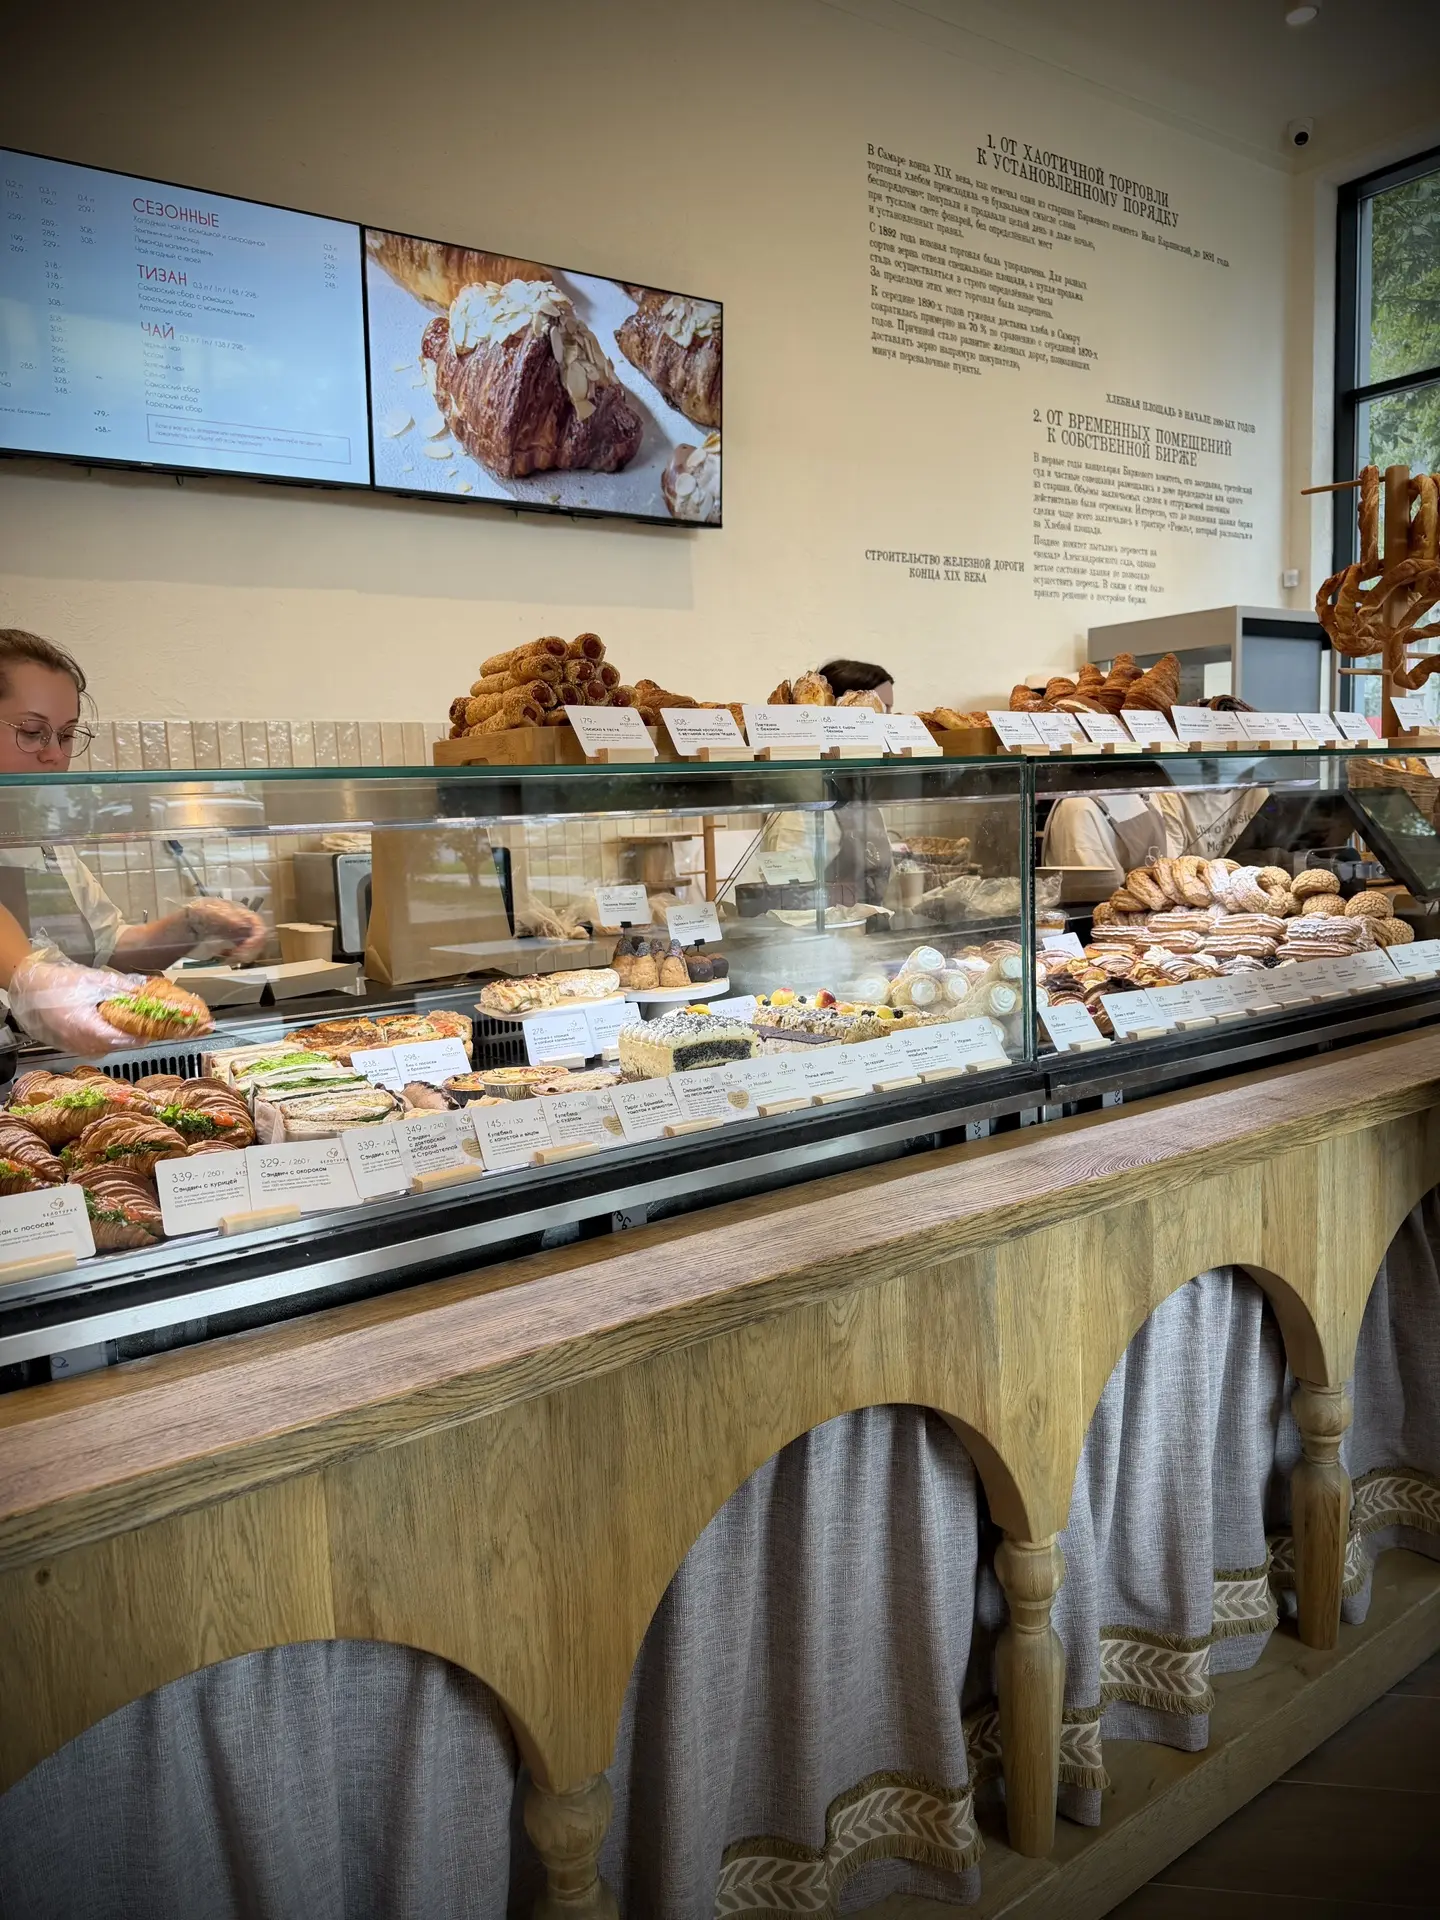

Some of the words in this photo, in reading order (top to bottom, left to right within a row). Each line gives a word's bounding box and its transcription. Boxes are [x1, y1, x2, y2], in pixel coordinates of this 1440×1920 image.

[987, 134, 995, 149] 1.
[1000, 136, 1017, 156] ОТ
[1023, 144, 1103, 185] ХАОТИЧНОЙ
[1109, 174, 1168, 207] ТОРГОВЛИ
[977, 147, 986, 165] К
[994, 154, 1116, 206] УСТАНОВЛЕННОМУ
[1123, 196, 1177, 226] ПОРЯДКУ
[867, 160, 901, 178] торговля
[904, 172, 930, 186] хлебом
[933, 180, 978, 200] происходила
[991, 196, 1029, 216] буквальном
[1032, 211, 1055, 224] смысле
[1058, 219, 1075, 230] слова
[133, 198, 218, 227] СЕЗОННЫЕ
[868, 190, 882, 201] при
[885, 195, 915, 210] тусклом
[919, 205, 938, 217] свете
[941, 209, 972, 228] фонарей,
[975, 218, 986, 230] без
[1037, 238, 1052, 249] мест
[876, 207, 933, 229] установленных
[936, 223, 963, 237] правил.
[133, 215, 166, 227] Холодный
[167, 222, 180, 230] чай
[188, 227, 220, 237] ромашкой
[227, 235, 265, 246] смородиной
[133, 225, 172, 238] Земляничный
[133, 235, 163, 248] Лимонад
[134, 246, 148, 254] Чай
[149, 249, 175, 258] ягодный
[137, 264, 186, 285] ТИЗАН
[137, 282, 175, 294] Самарский
[176, 289, 194, 299] сбор
[202, 295, 233, 304] ромашкой
[138, 293, 176, 304] Карельский
[178, 299, 196, 308] сбор
[203, 306, 254, 317] можжевельником
[139, 303, 173, 314] Алтайский
[174, 309, 192, 317] сбор
[871, 284, 877, 296] К
[881, 291, 914, 304] середине
[945, 305, 964, 316] годов
[967, 310, 995, 323] гужевая
[998, 318, 1027, 330] доставка
[1030, 324, 1048, 335] хлеба
[1057, 328, 1080, 345] Самару
[140, 321, 174, 339] ЧАЙ
[871, 331, 913, 346] доставлять
[916, 341, 937, 352] зерно
[939, 345, 975, 361] напрямую
[978, 354, 1020, 370] покупателю,
[872, 346, 896, 359] минуя
[899, 352, 949, 368] перевалочные
[952, 362, 981, 375] пункты.
[144, 379, 181, 390] Самарский
[182, 385, 200, 393] сбор
[145, 390, 178, 399] Алтайский
[180, 394, 198, 402] сбор
[145, 399, 183, 410] Карельский
[185, 404, 202, 413] сбор
[1106, 393, 1140, 409] ХЛЕБНАЯ
[1142, 401, 1176, 417] ПЛОЩАДЬ
[1178, 408, 1182, 418] В
[1184, 410, 1211, 424] НАЧАЛЕ
[1237, 421, 1255, 433] ГОДОВ
[1033, 408, 1041, 422] 2.
[1046, 409, 1062, 426] ОТ
[1068, 412, 1149, 441] ВРЕМЕННЫХ
[1156, 429, 1231, 455] ПОМЕЩЕНИЙ
[1047, 426, 1055, 442] К
[1061, 430, 1149, 458] СОБСТВЕННОЙ
[1155, 445, 1196, 466] БИРЖЕ
[865, 549, 939, 564] СТРОИТЕЛЬСТВО
[943, 556, 990, 569] ЖЕЛЕЗНОЙ
[993, 559, 1024, 571] ДОРОГИ
[909, 567, 939, 580] КОНЦА
[944, 569, 960, 581] XIX
[964, 571, 986, 582] ВЕКА
[551, 1101, 572, 1110] 249.-
[554, 1111, 579, 1119] Кулебяка
[405, 1124, 427, 1135] 349.-
[486, 1119, 506, 1128] 145.-
[407, 1134, 431, 1142] Сэндвич
[488, 1130, 513, 1138] Кулебяка
[494, 1134, 519, 1142] капустой
[357, 1141, 380, 1152] 339.-
[410, 1144, 438, 1153] колбасой
[414, 1136, 446, 1147] докторской
[360, 1152, 384, 1160] Сэндвич
[417, 1144, 458, 1157] Страчателлой
[260, 1158, 285, 1168] 329.-
[171, 1171, 198, 1183] 339.-
[296, 1167, 327, 1175] окороком
[173, 1185, 202, 1193] Сэндвич
[210, 1178, 238, 1188] курицей
[42, 1208, 77, 1217] БЕЛОТУРКА
[21, 1222, 54, 1232] лососем
